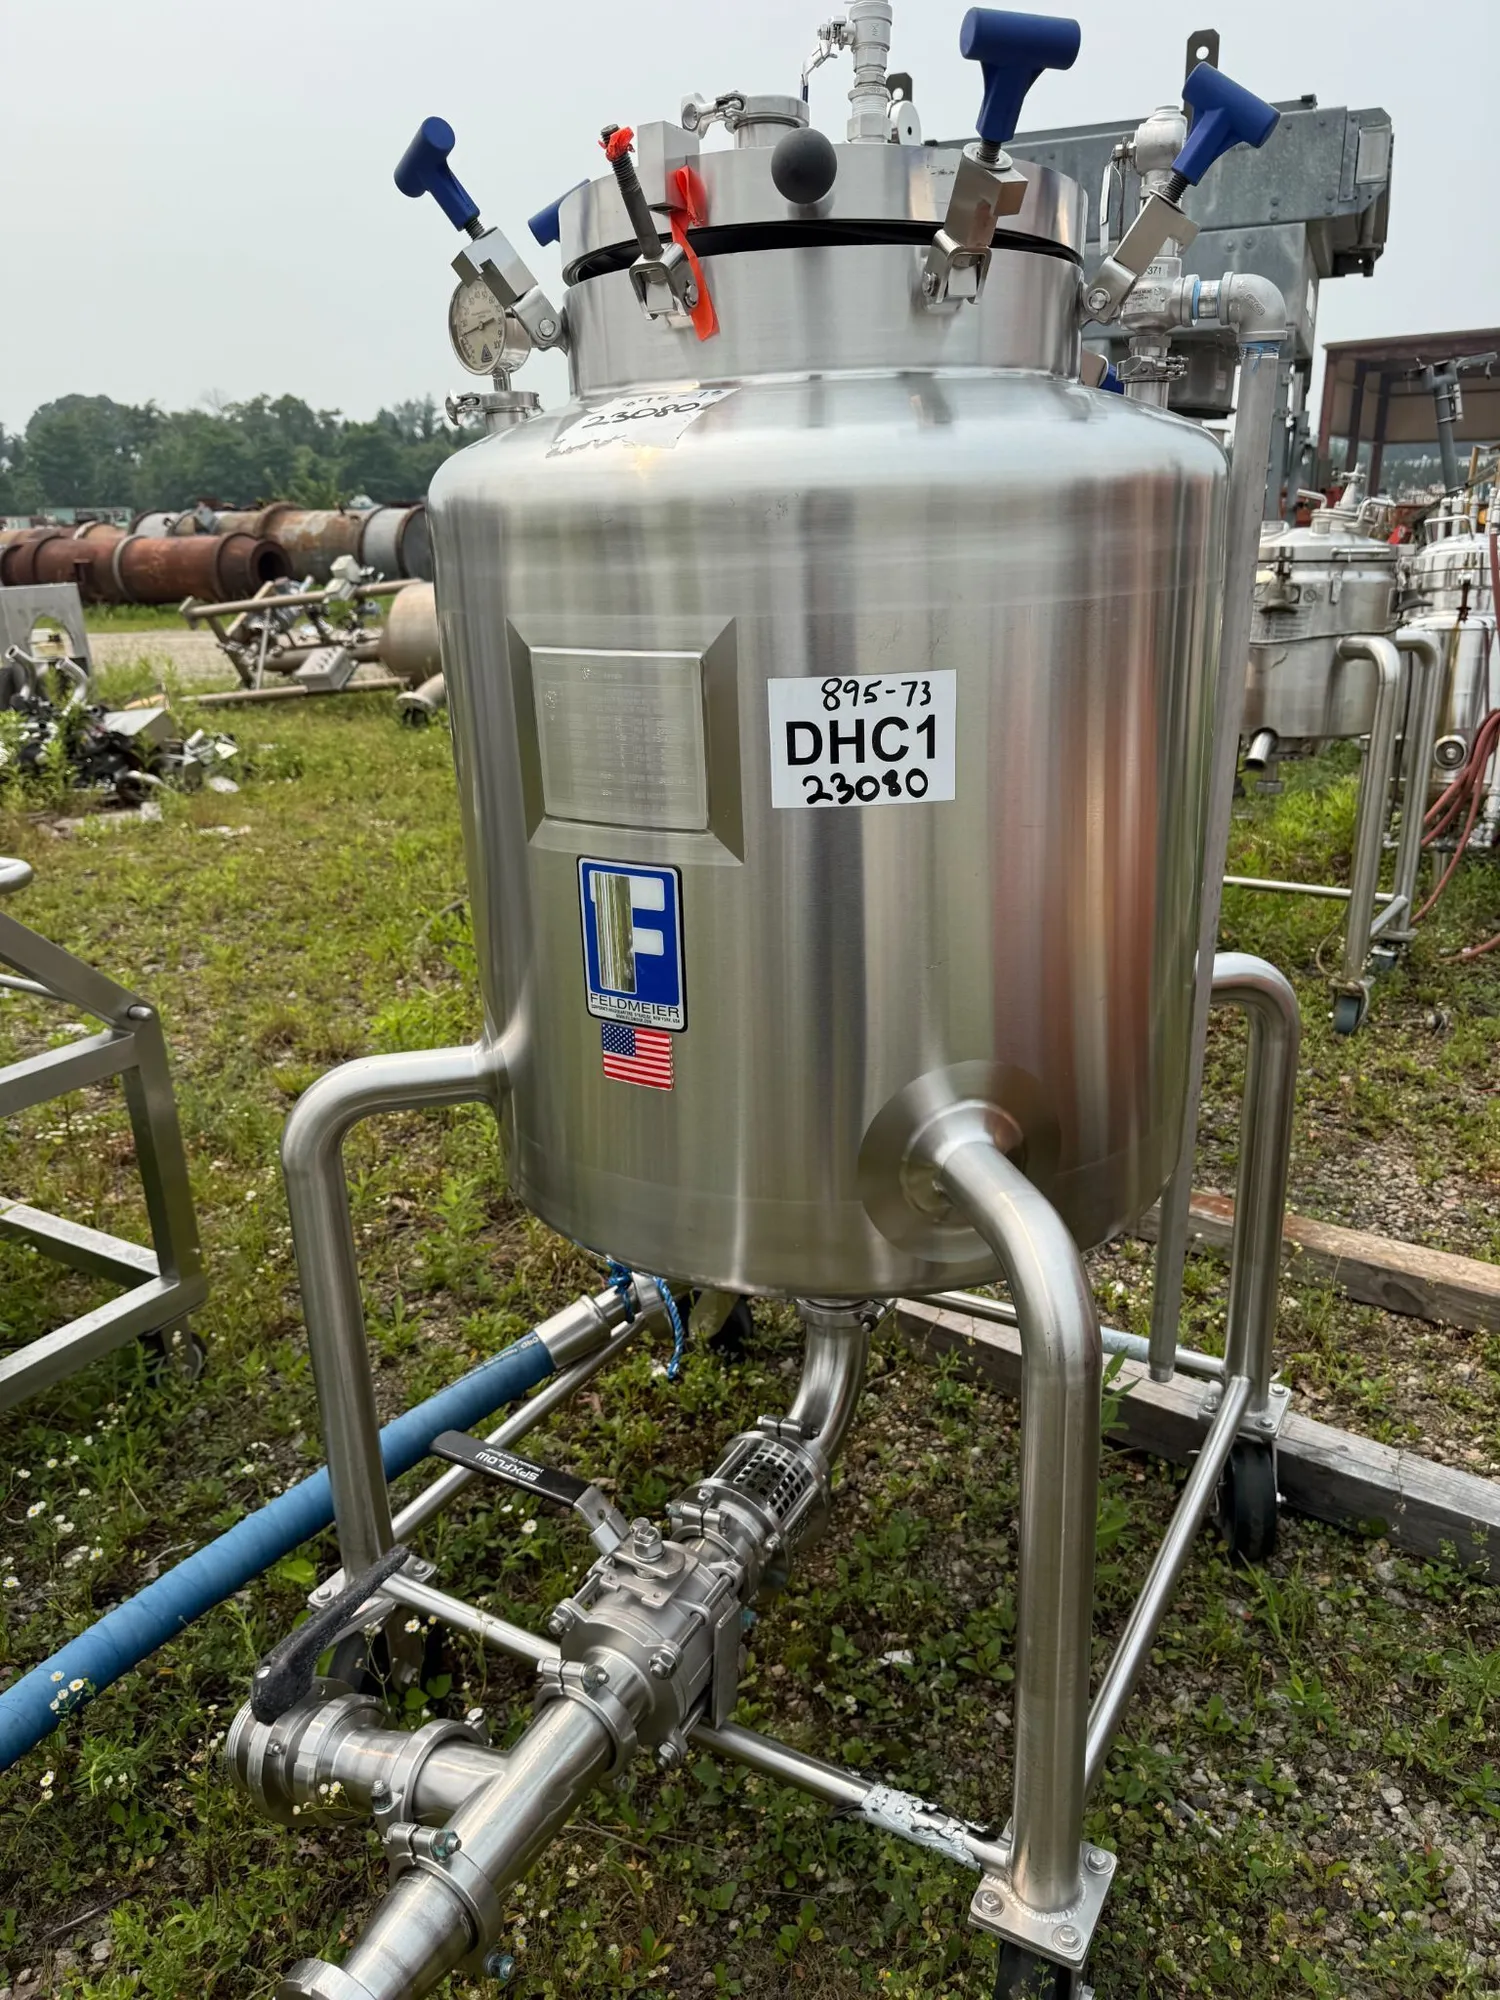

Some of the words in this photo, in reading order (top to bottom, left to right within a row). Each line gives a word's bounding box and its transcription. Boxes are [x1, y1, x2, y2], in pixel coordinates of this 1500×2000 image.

[581, 402, 700, 429] 23080
[821, 677, 931, 711] 895-73
[786, 714, 936, 766] DHC1
[802, 768, 929, 804] 23080
[590, 993, 680, 1018] FELDMEIER
